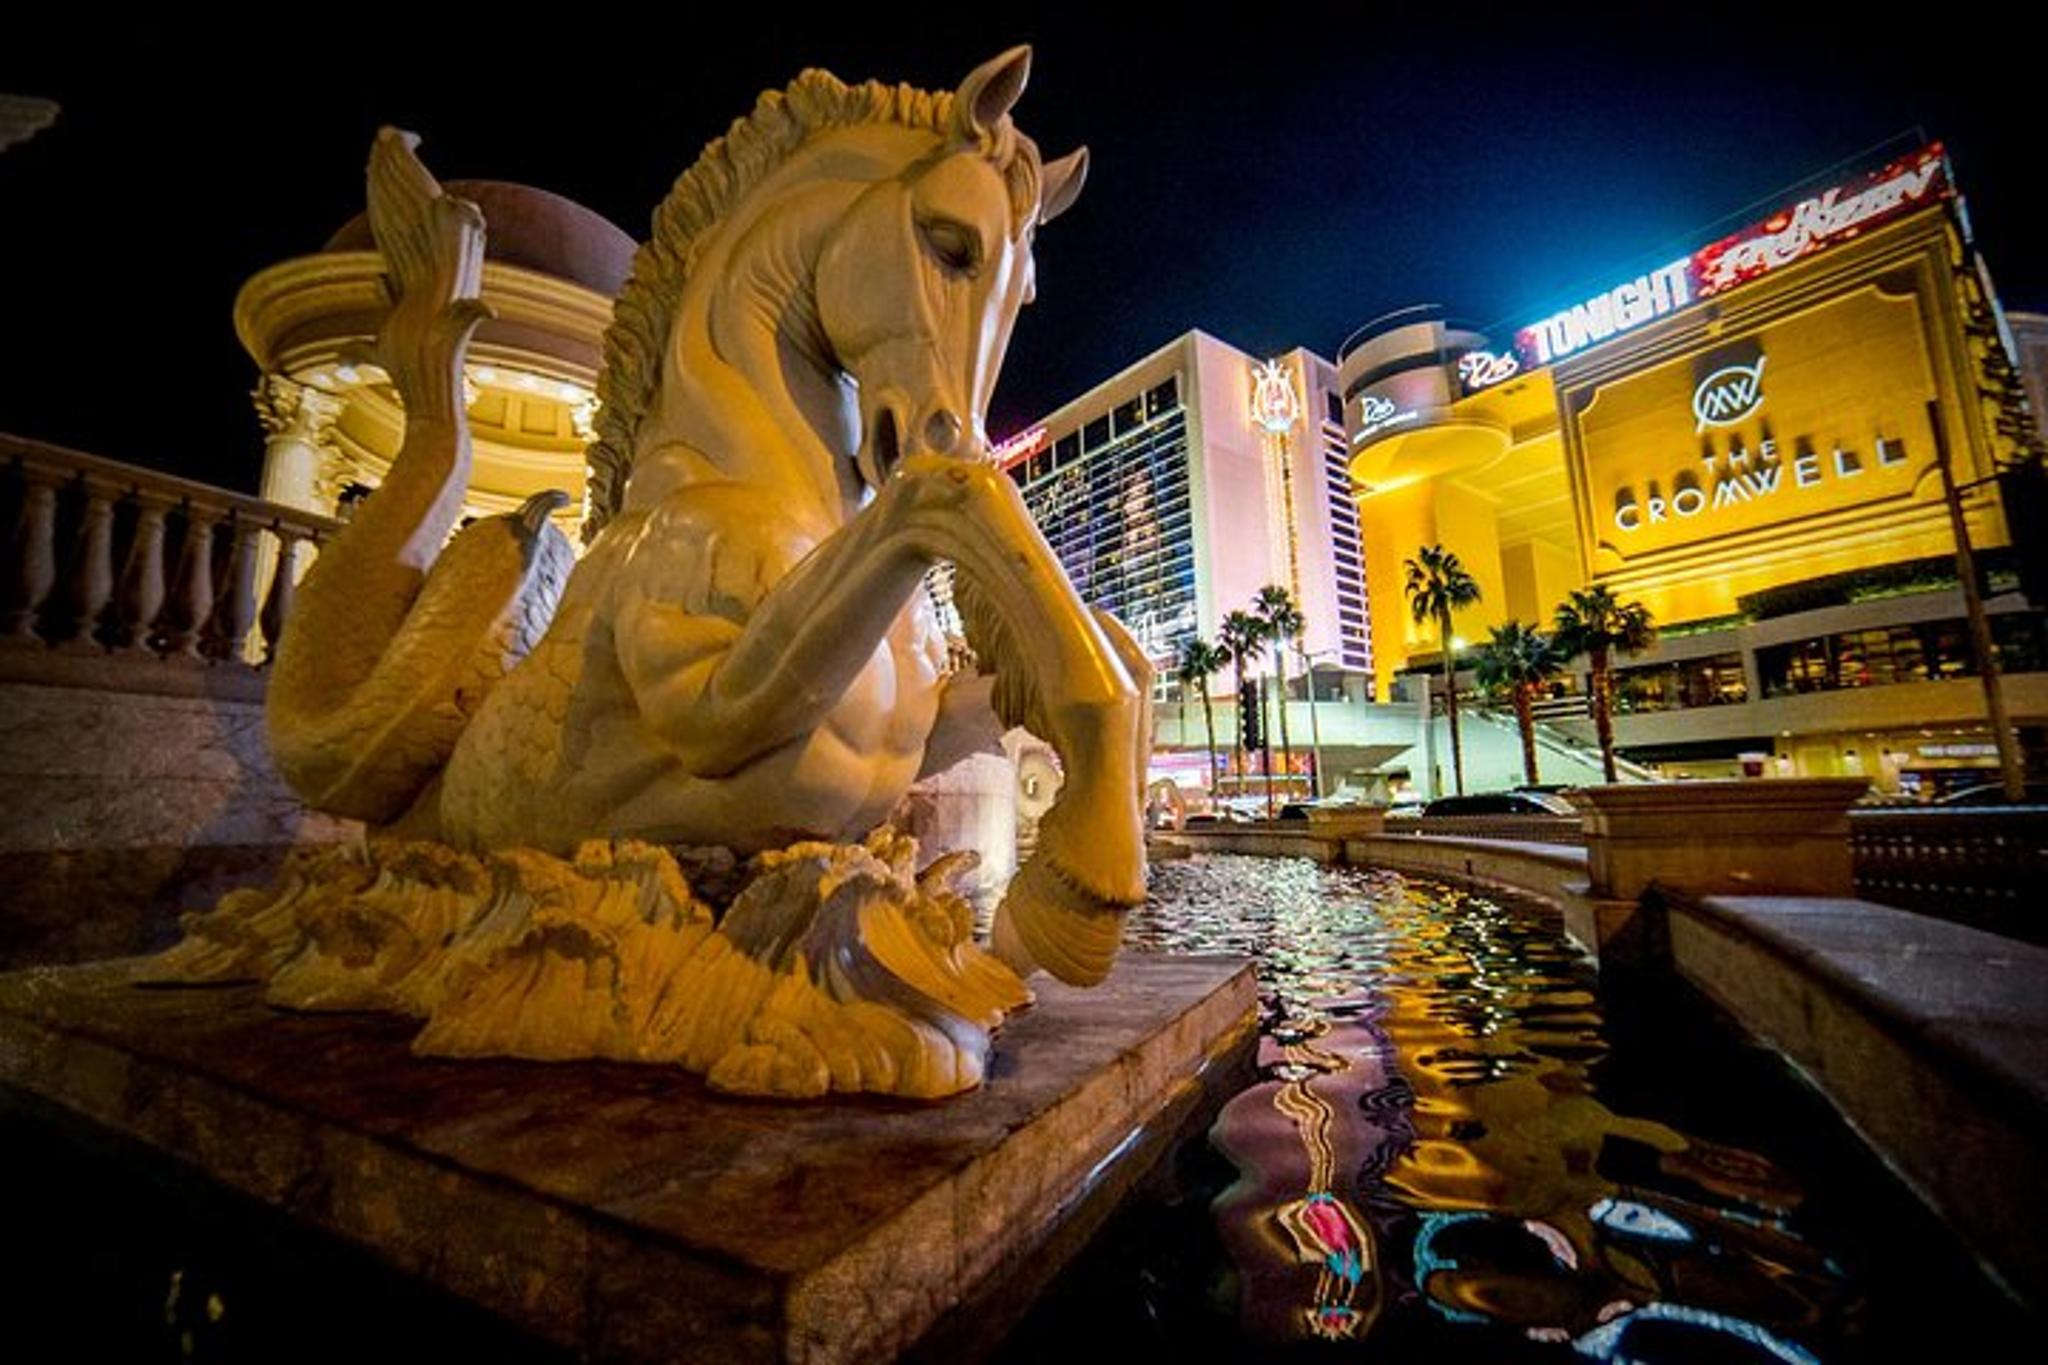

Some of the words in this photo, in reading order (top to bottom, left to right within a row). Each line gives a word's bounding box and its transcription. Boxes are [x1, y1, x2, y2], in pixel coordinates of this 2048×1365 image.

[1532, 257, 1690, 363] TONIGHT
[1615, 438, 1908, 532] CROMWELL
[1703, 439, 1776, 474] THE
